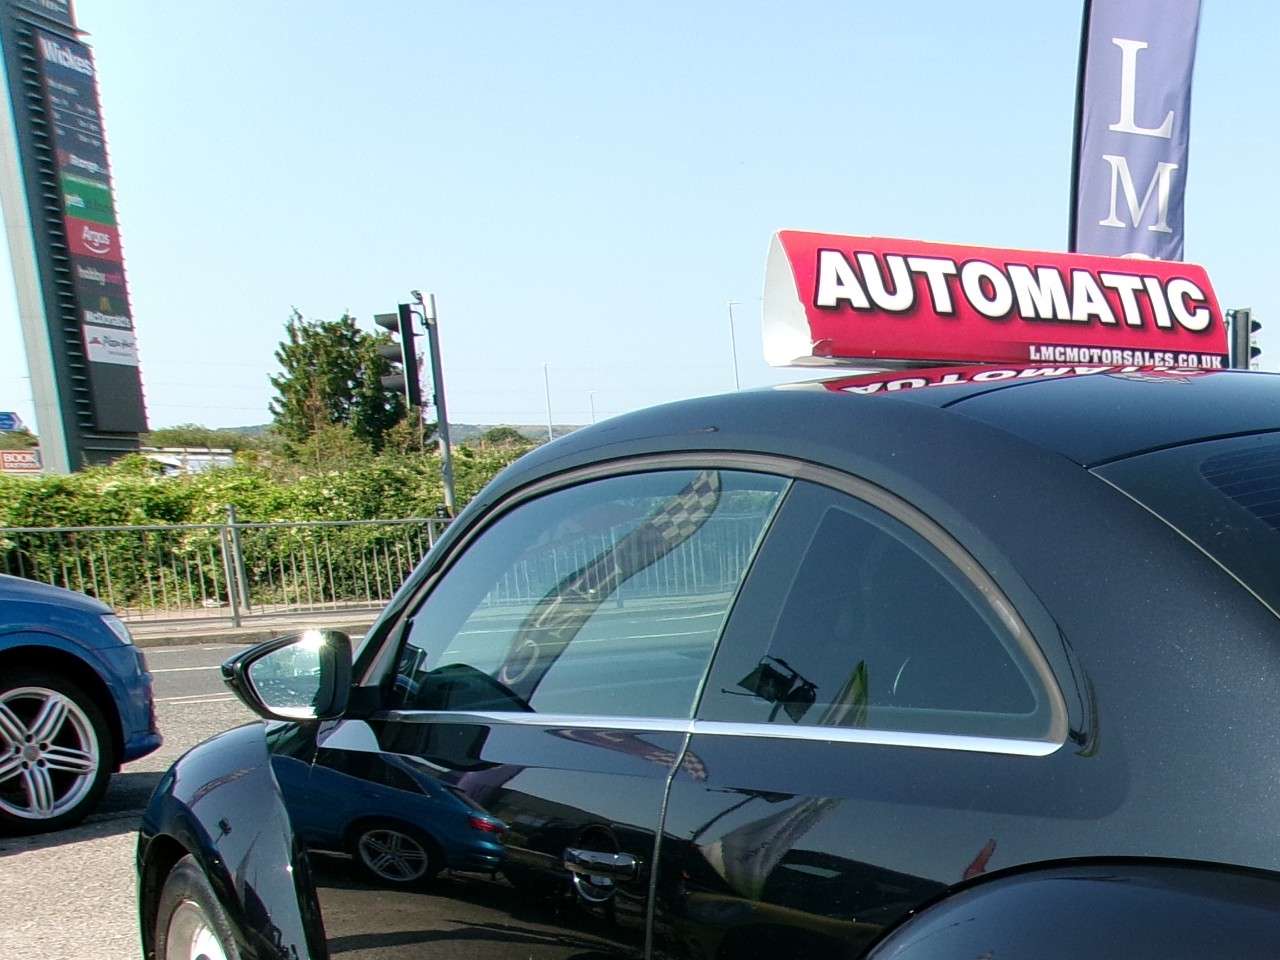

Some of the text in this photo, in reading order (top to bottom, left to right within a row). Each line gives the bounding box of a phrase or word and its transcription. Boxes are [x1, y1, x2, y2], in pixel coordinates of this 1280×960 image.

[1099, 37, 1179, 261] LM
[82, 225, 111, 247] Argos
[815, 249, 1212, 332] AUTOMATIC
[1029, 345, 1223, 369] LMCMOTORSALES.CO.UK
